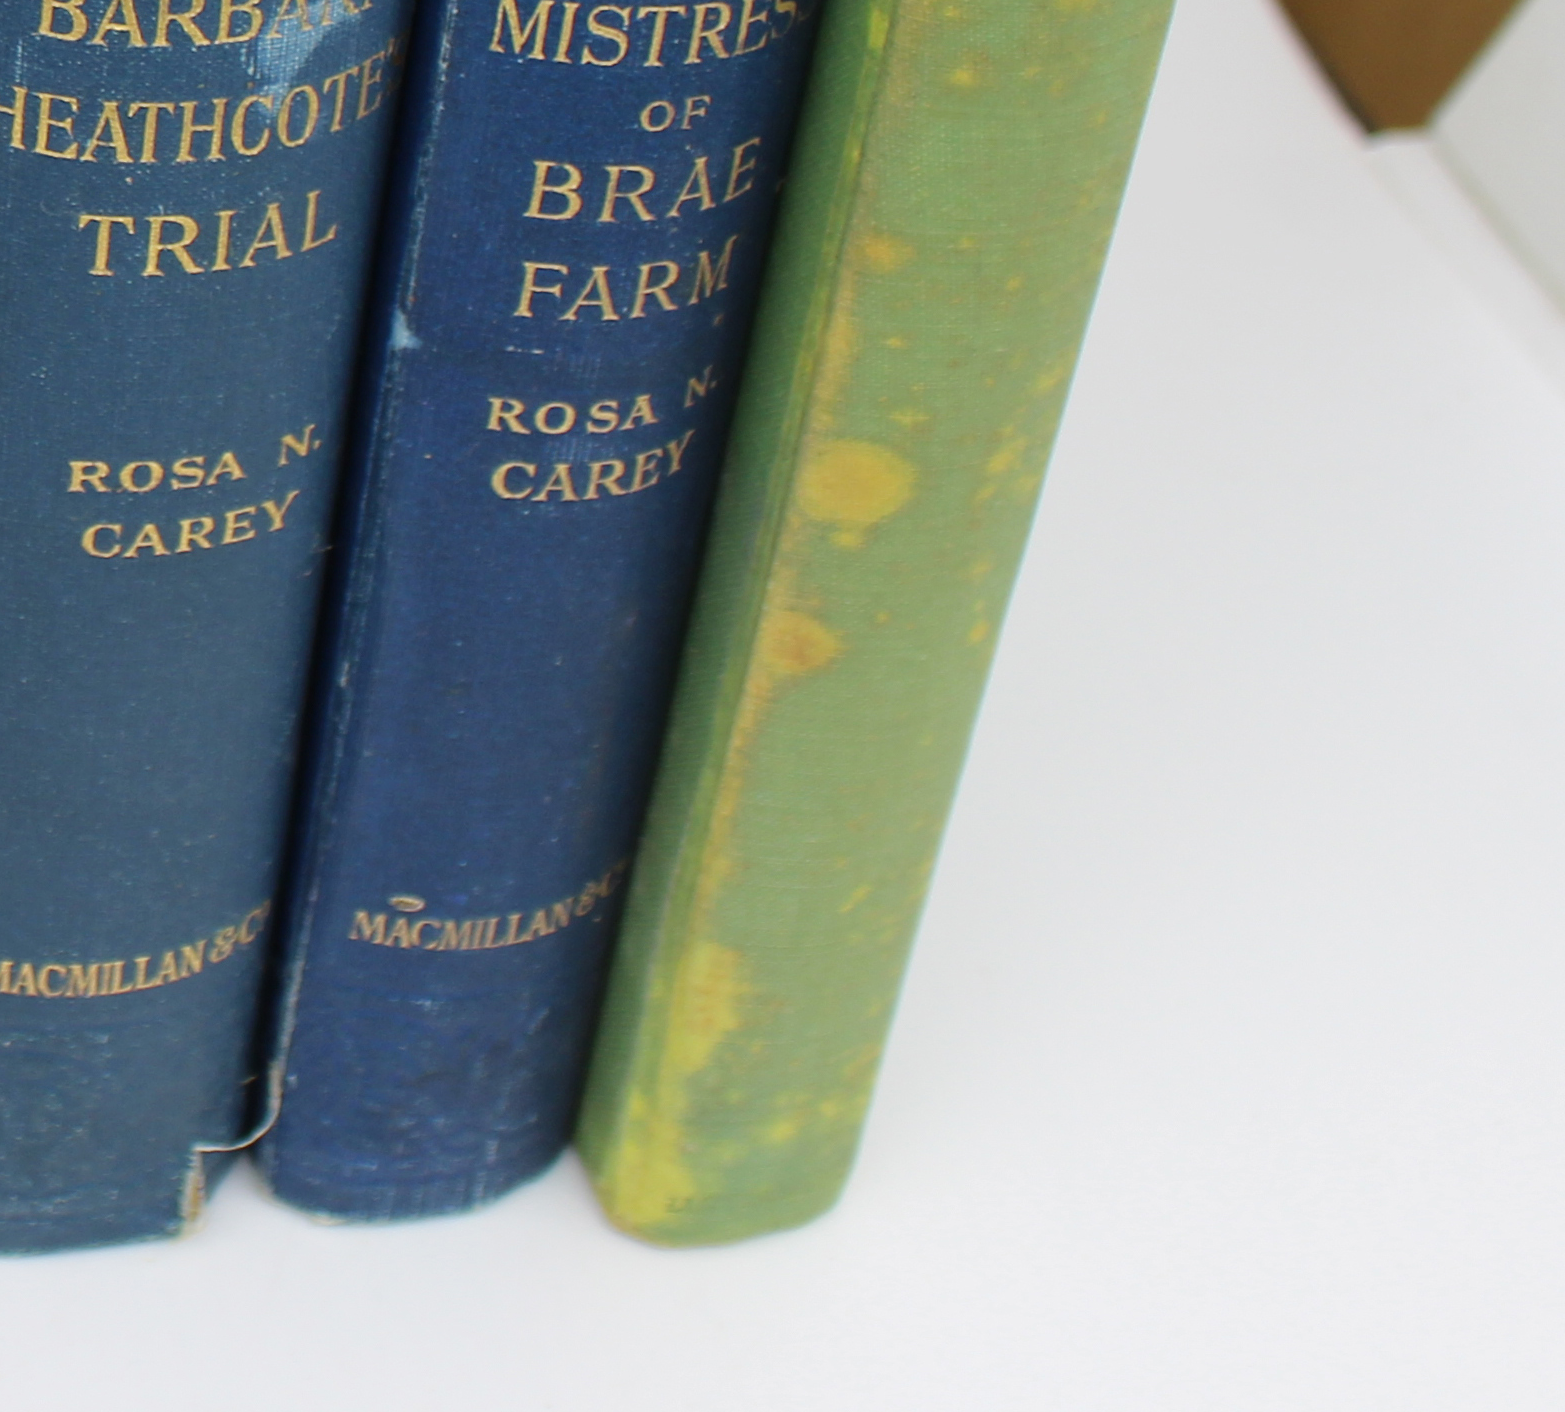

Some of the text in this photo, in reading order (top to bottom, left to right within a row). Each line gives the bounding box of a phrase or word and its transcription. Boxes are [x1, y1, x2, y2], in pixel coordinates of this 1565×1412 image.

[639, 95, 712, 133] OF
[523, 137, 762, 223] BRAE
[77, 189, 338, 277] TRIAL
[513, 233, 739, 322] FARM
[485, 365, 717, 436] ROSA N.
[67, 423, 322, 494] ROSA N.
[491, 429, 696, 502] CAREY
[80, 490, 300, 560] CAREY
